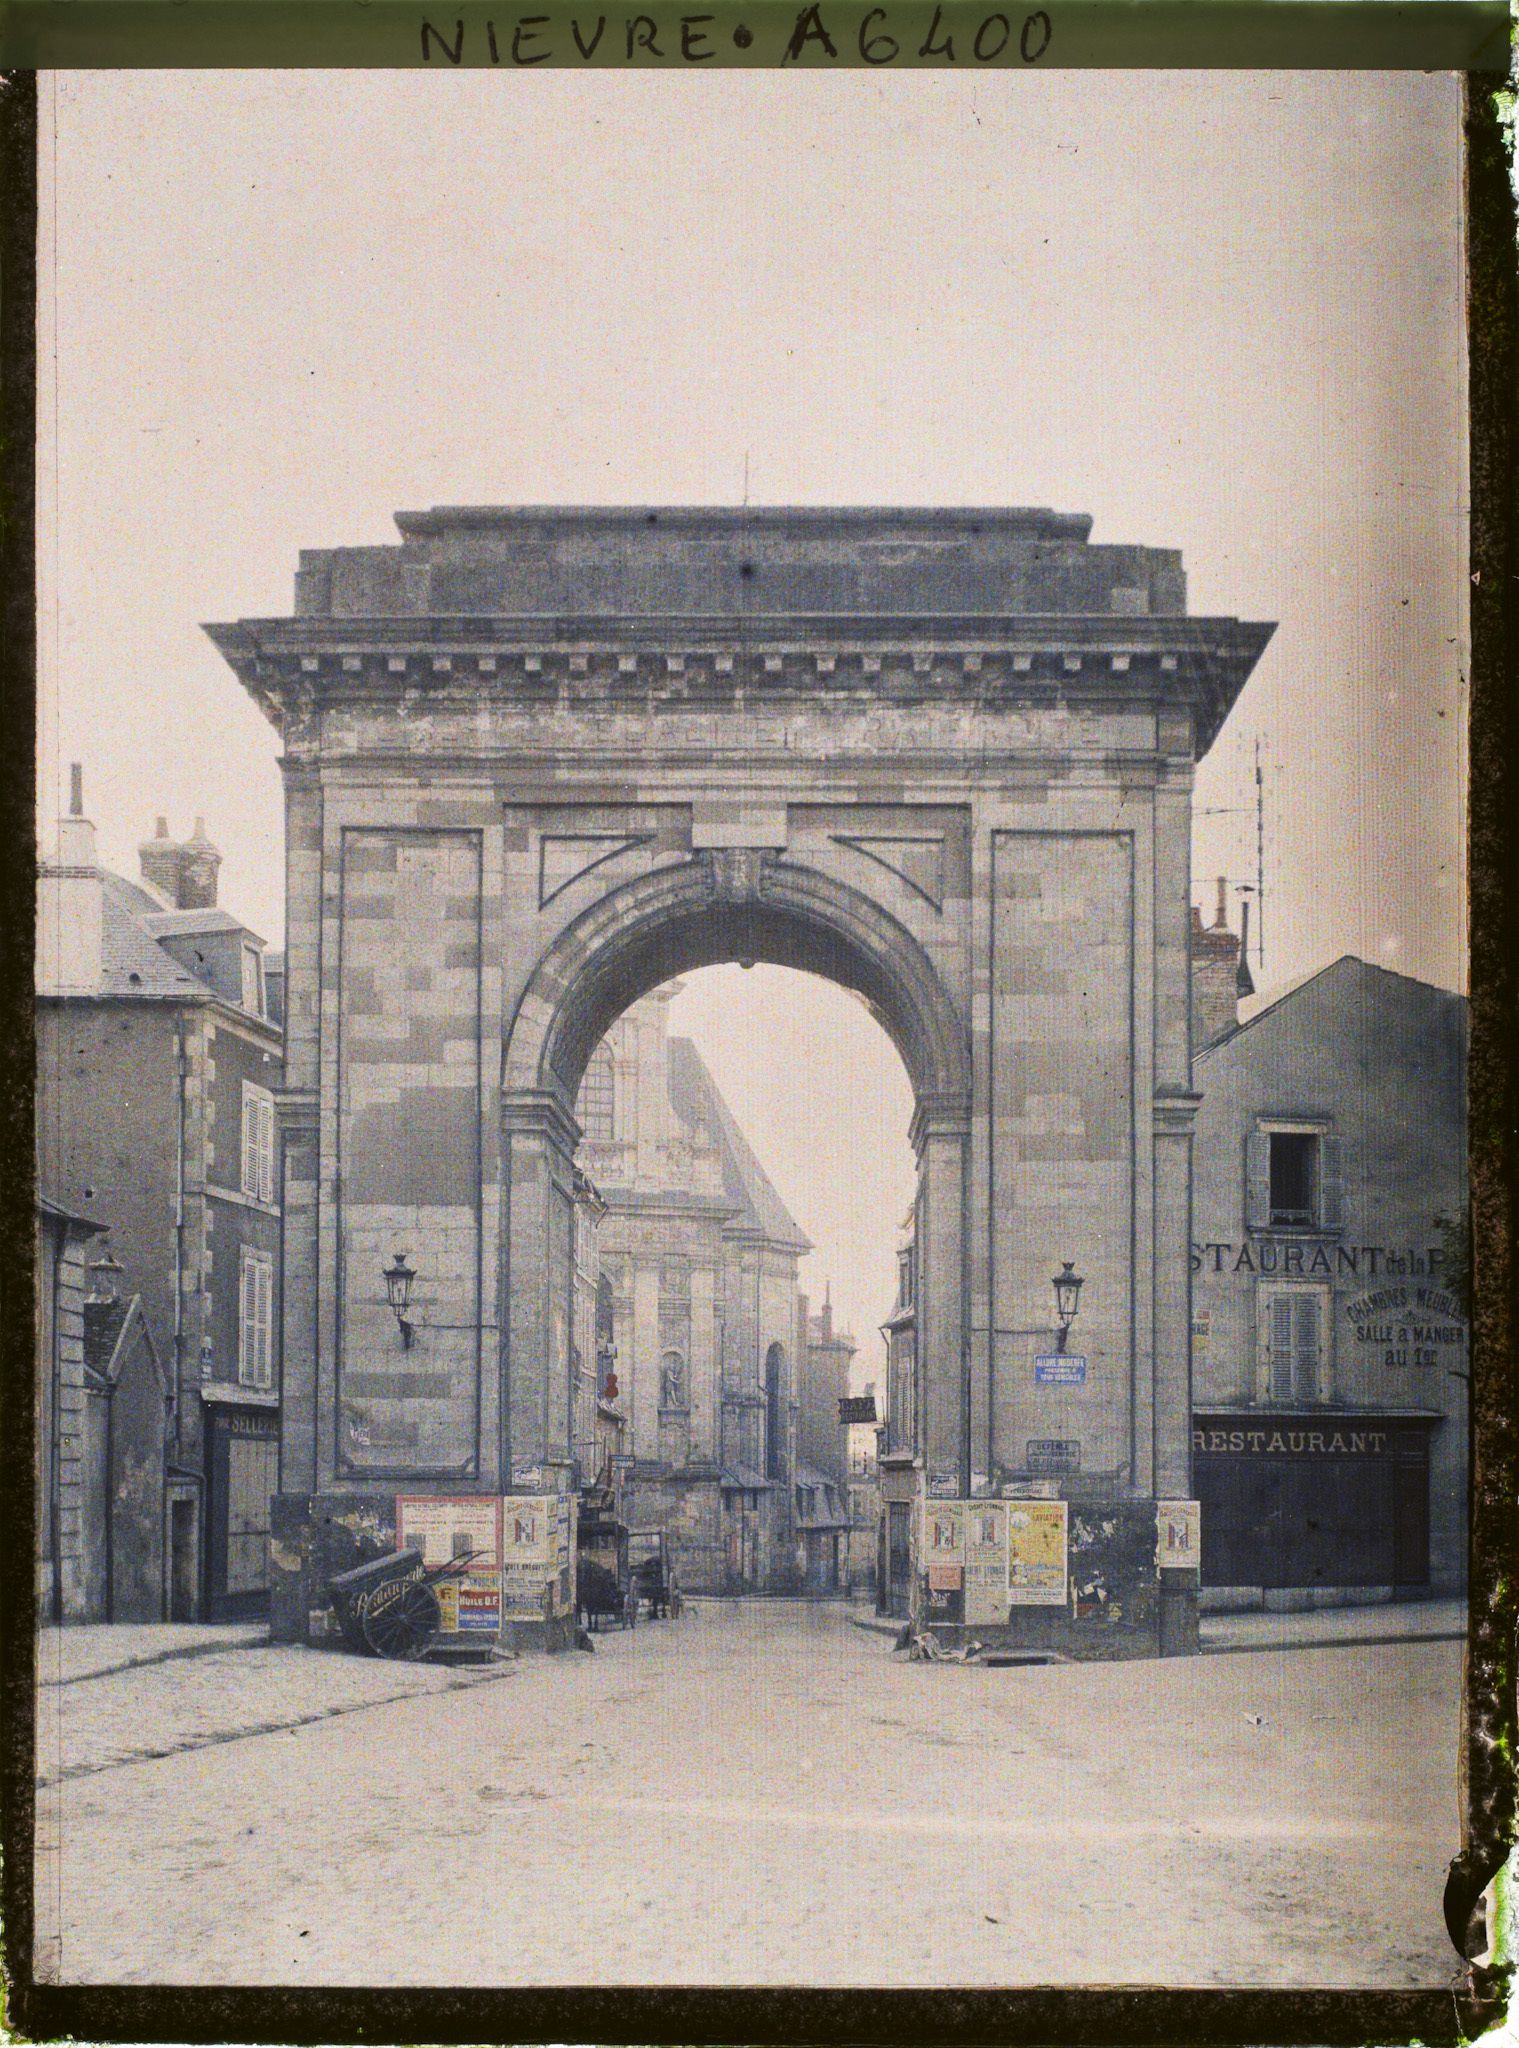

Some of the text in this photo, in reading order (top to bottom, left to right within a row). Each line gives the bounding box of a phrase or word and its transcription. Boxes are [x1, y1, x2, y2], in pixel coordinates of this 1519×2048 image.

[421, 3, 1053, 68] NIEVRE A6400
[1347, 1287, 1407, 1324] CHAMBRES
[1357, 1325, 1393, 1343] SALLE
[1413, 1326, 1464, 1344] MANGER
[1385, 1349, 1407, 1367] au
[1193, 1430, 1387, 1453] RESTAURANT
